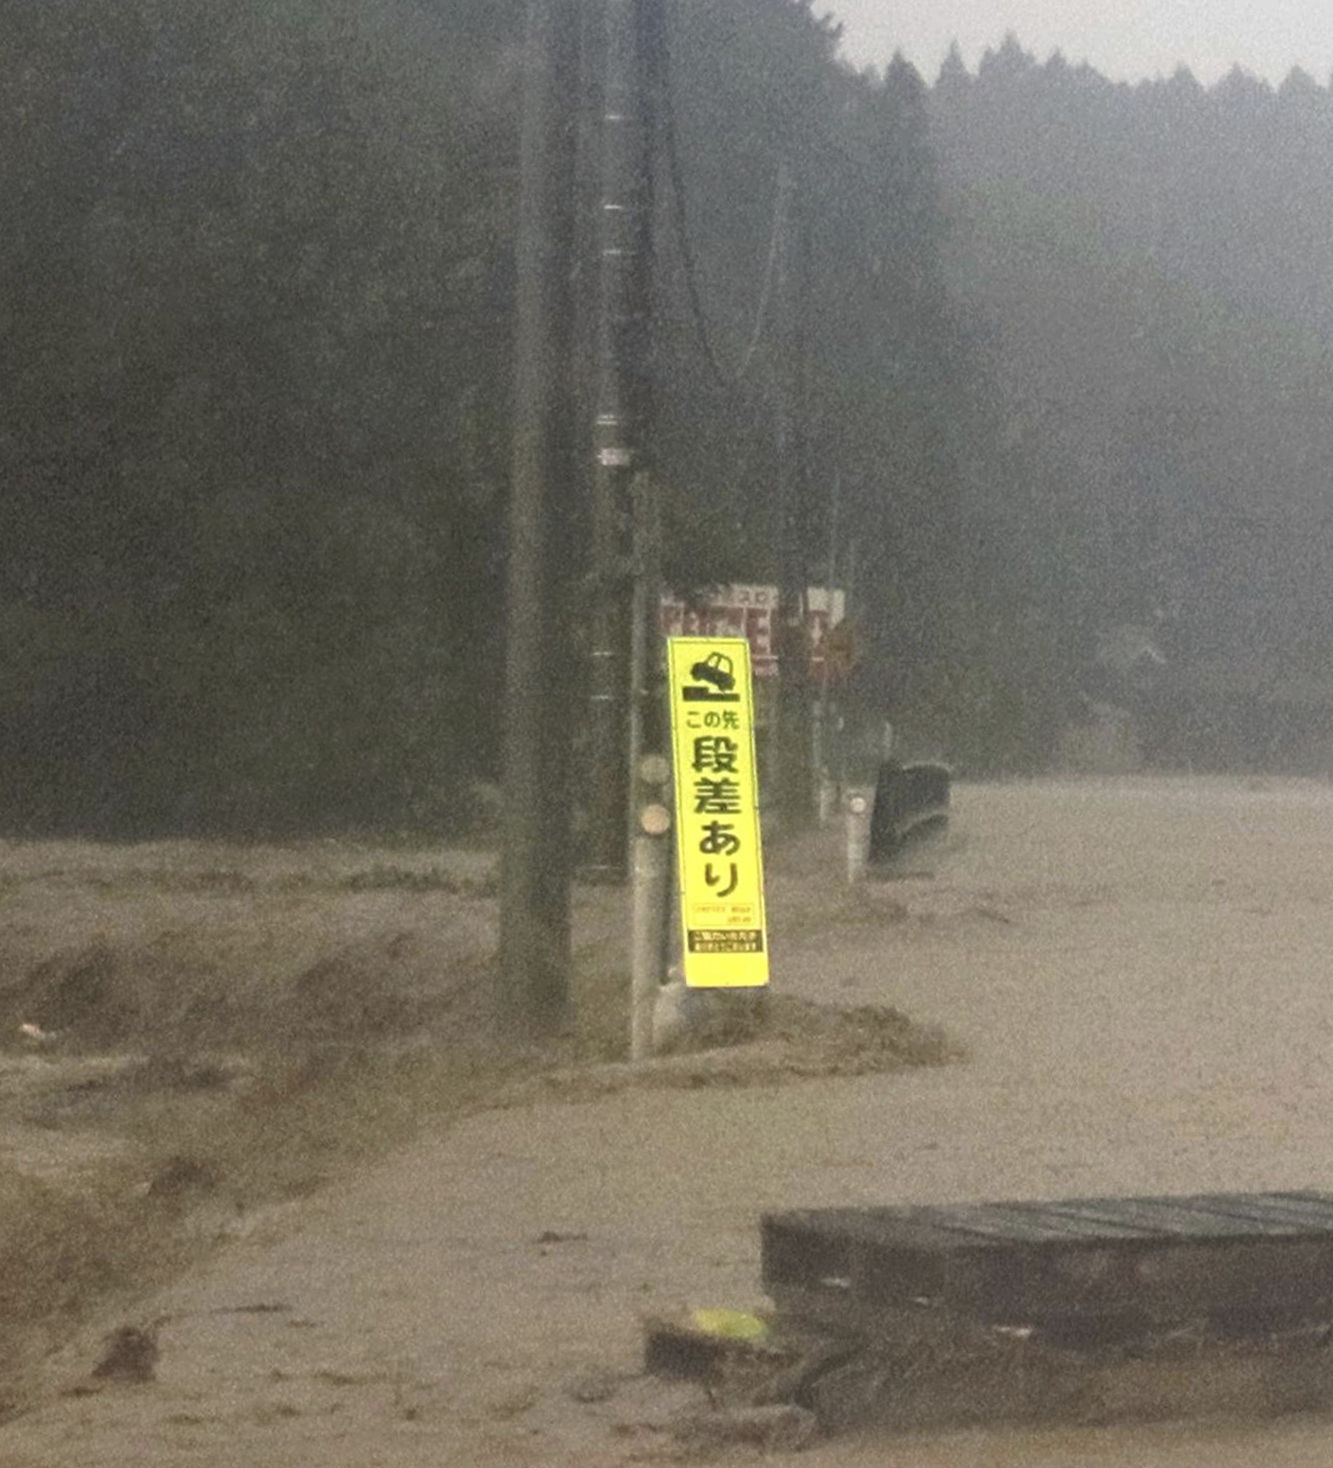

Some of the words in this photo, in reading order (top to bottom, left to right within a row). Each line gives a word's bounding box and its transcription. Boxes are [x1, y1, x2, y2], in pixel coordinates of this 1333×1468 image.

[686, 710, 740, 729] この先
[692, 735, 742, 897] 段差あり
